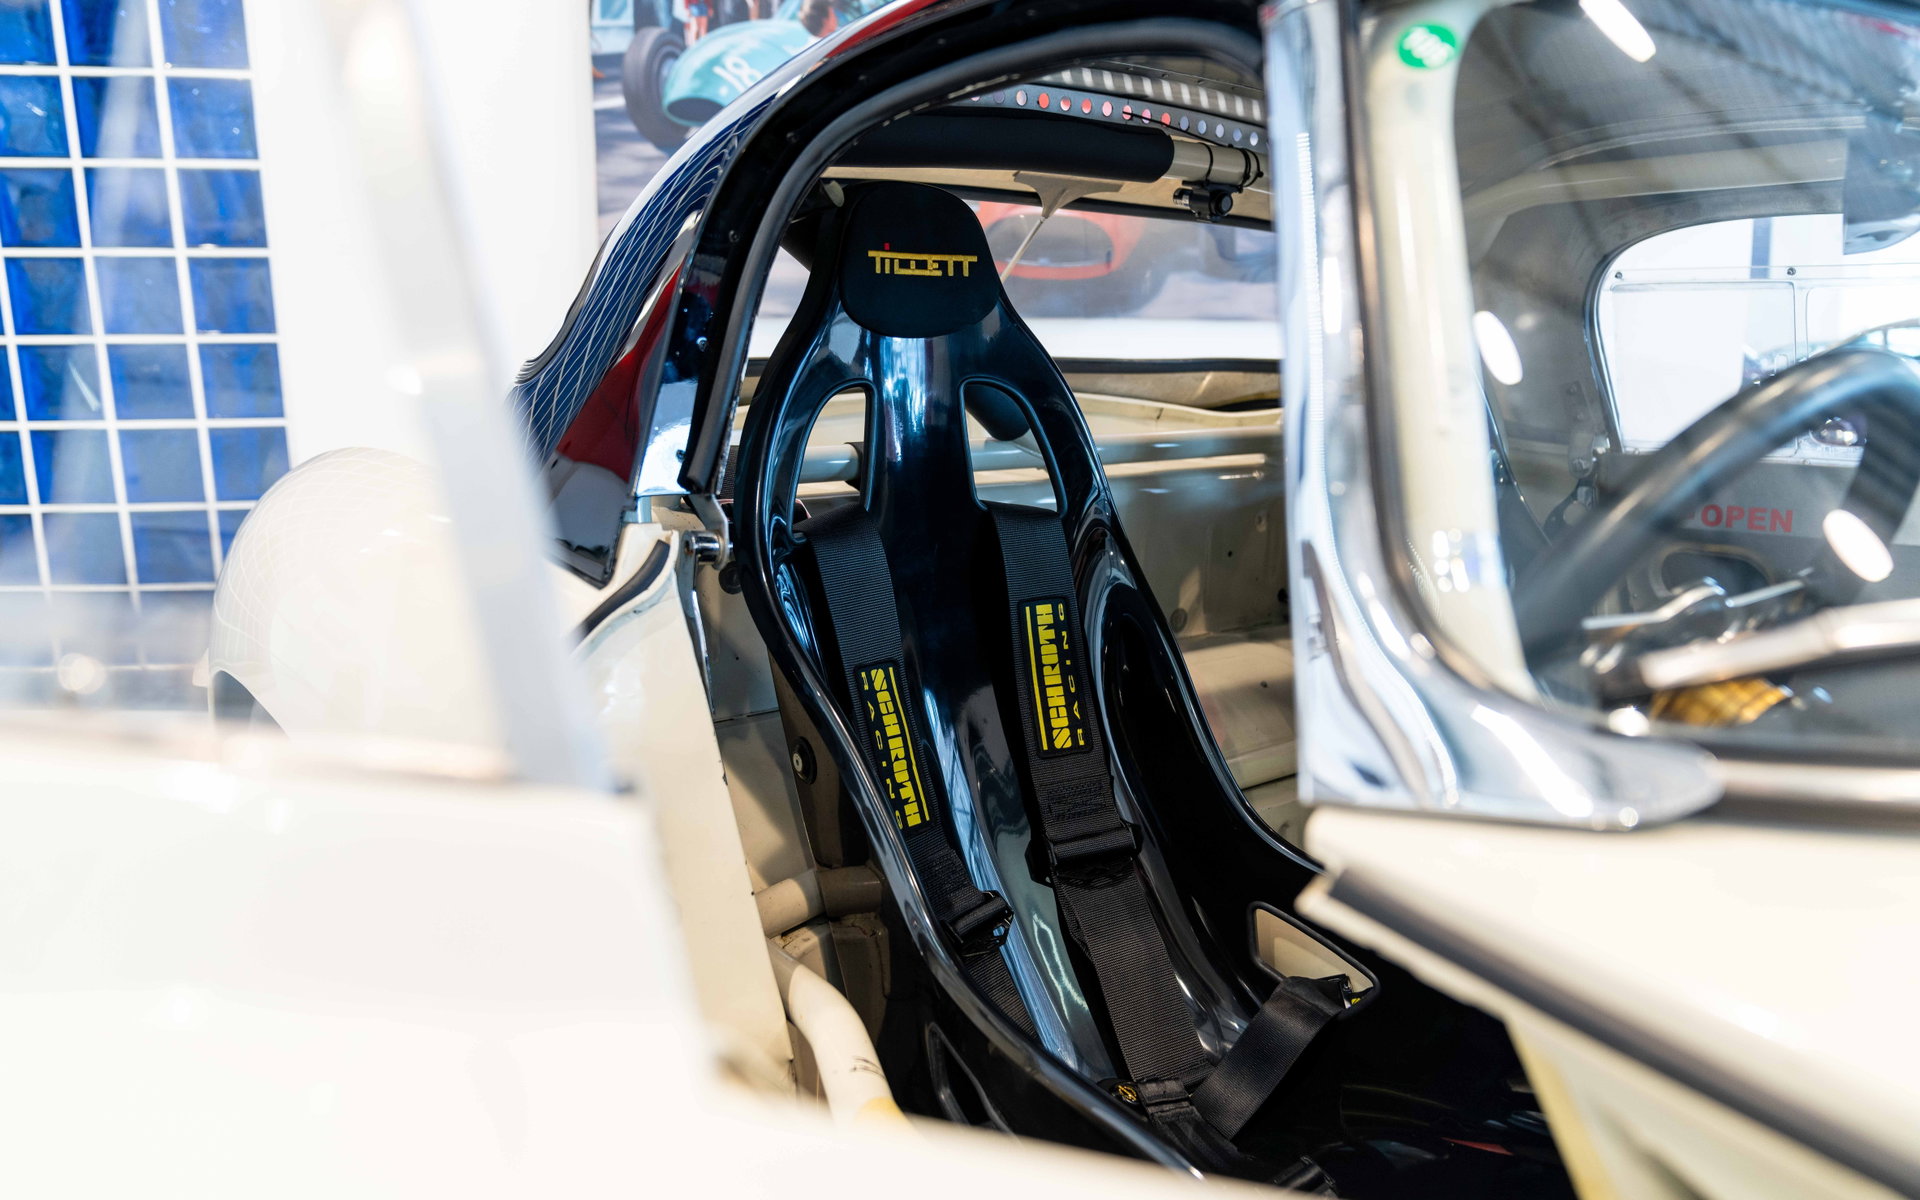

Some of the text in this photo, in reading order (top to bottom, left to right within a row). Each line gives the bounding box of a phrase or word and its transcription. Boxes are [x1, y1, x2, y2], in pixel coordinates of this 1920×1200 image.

[712, 55, 763, 94] 18
[1701, 504, 1793, 533] OPEN
[1035, 603, 1073, 750] SCHROTH
[1057, 602, 1085, 746] RACING
[860, 671, 904, 830] RACING
[870, 668, 922, 828] SCHROTH
